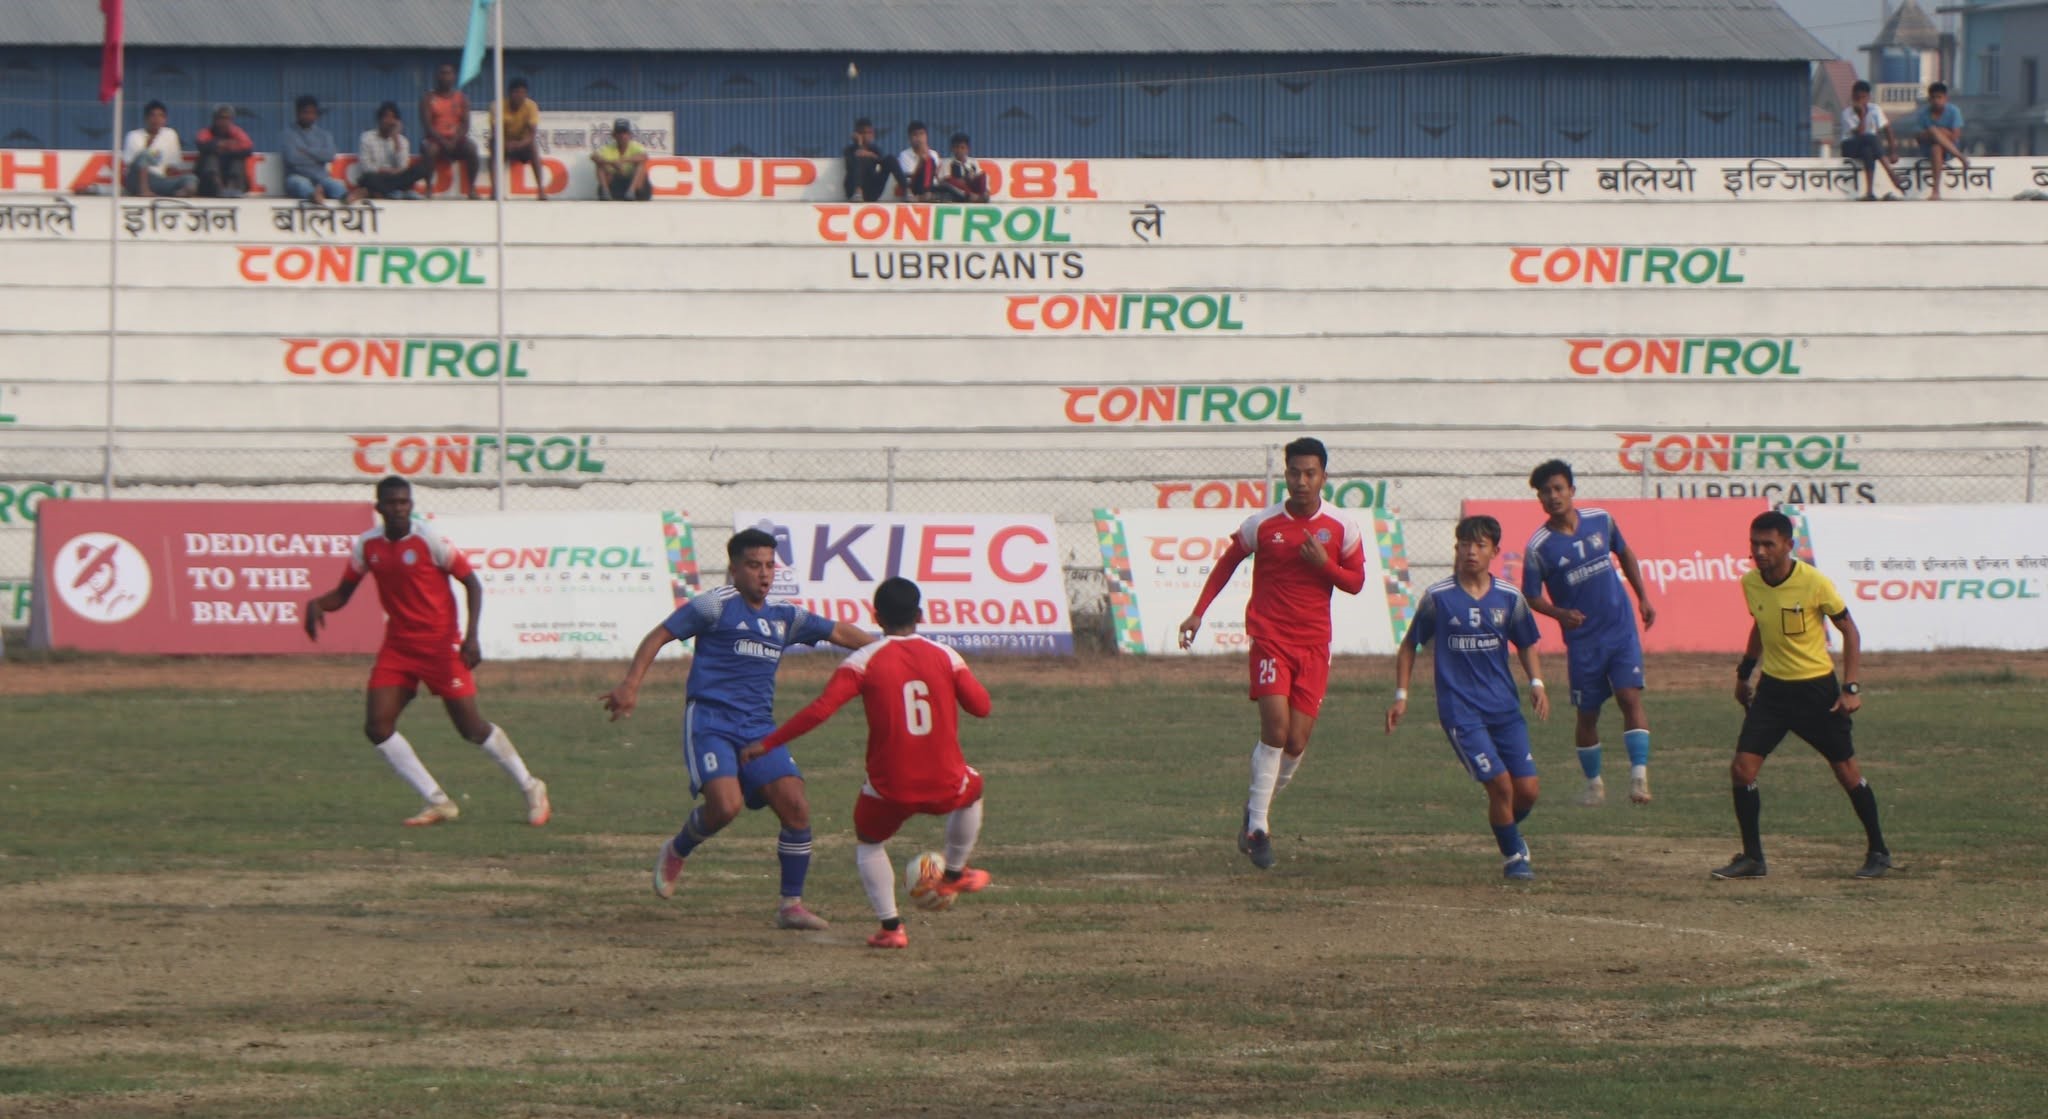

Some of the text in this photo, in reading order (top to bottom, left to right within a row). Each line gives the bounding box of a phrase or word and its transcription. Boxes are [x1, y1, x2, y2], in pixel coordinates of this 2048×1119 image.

[643, 158, 817, 198] CUP
[1489, 160, 1569, 195] गाडी
[1597, 158, 1696, 195] बलियो
[813, 203, 1072, 242] CONTROL
[1130, 203, 1165, 242] ले
[237, 246, 486, 284] CONTROL
[851, 251, 1083, 280] LUBRICANTS
[1510, 247, 1744, 284] CONTROL
[1005, 294, 1243, 331] CONTROL
[281, 338, 528, 378] CONTROL
[1567, 338, 1801, 375] CONTROL
[1062, 386, 1302, 423] CONTROL
[349, 434, 604, 475] CONTROL
[1616, 433, 1859, 472] CONTROL
[808, 523, 1050, 584] KIEC
[1572, 540, 1586, 559] 7
[187, 566, 312, 590] TO THE
[484, 572, 651, 582] UBRICANTS
[1850, 578, 2040, 601] CONTROL
[191, 601, 299, 625] BRAVE
[756, 617, 772, 637] 8
[920, 598, 1058, 625] BROAD
[1468, 607, 1482, 628] 5
[1259, 658, 1277, 684] 25
[902, 680, 933, 737] 6
[703, 751, 719, 772] 8
[1473, 752, 1492, 773] 5
